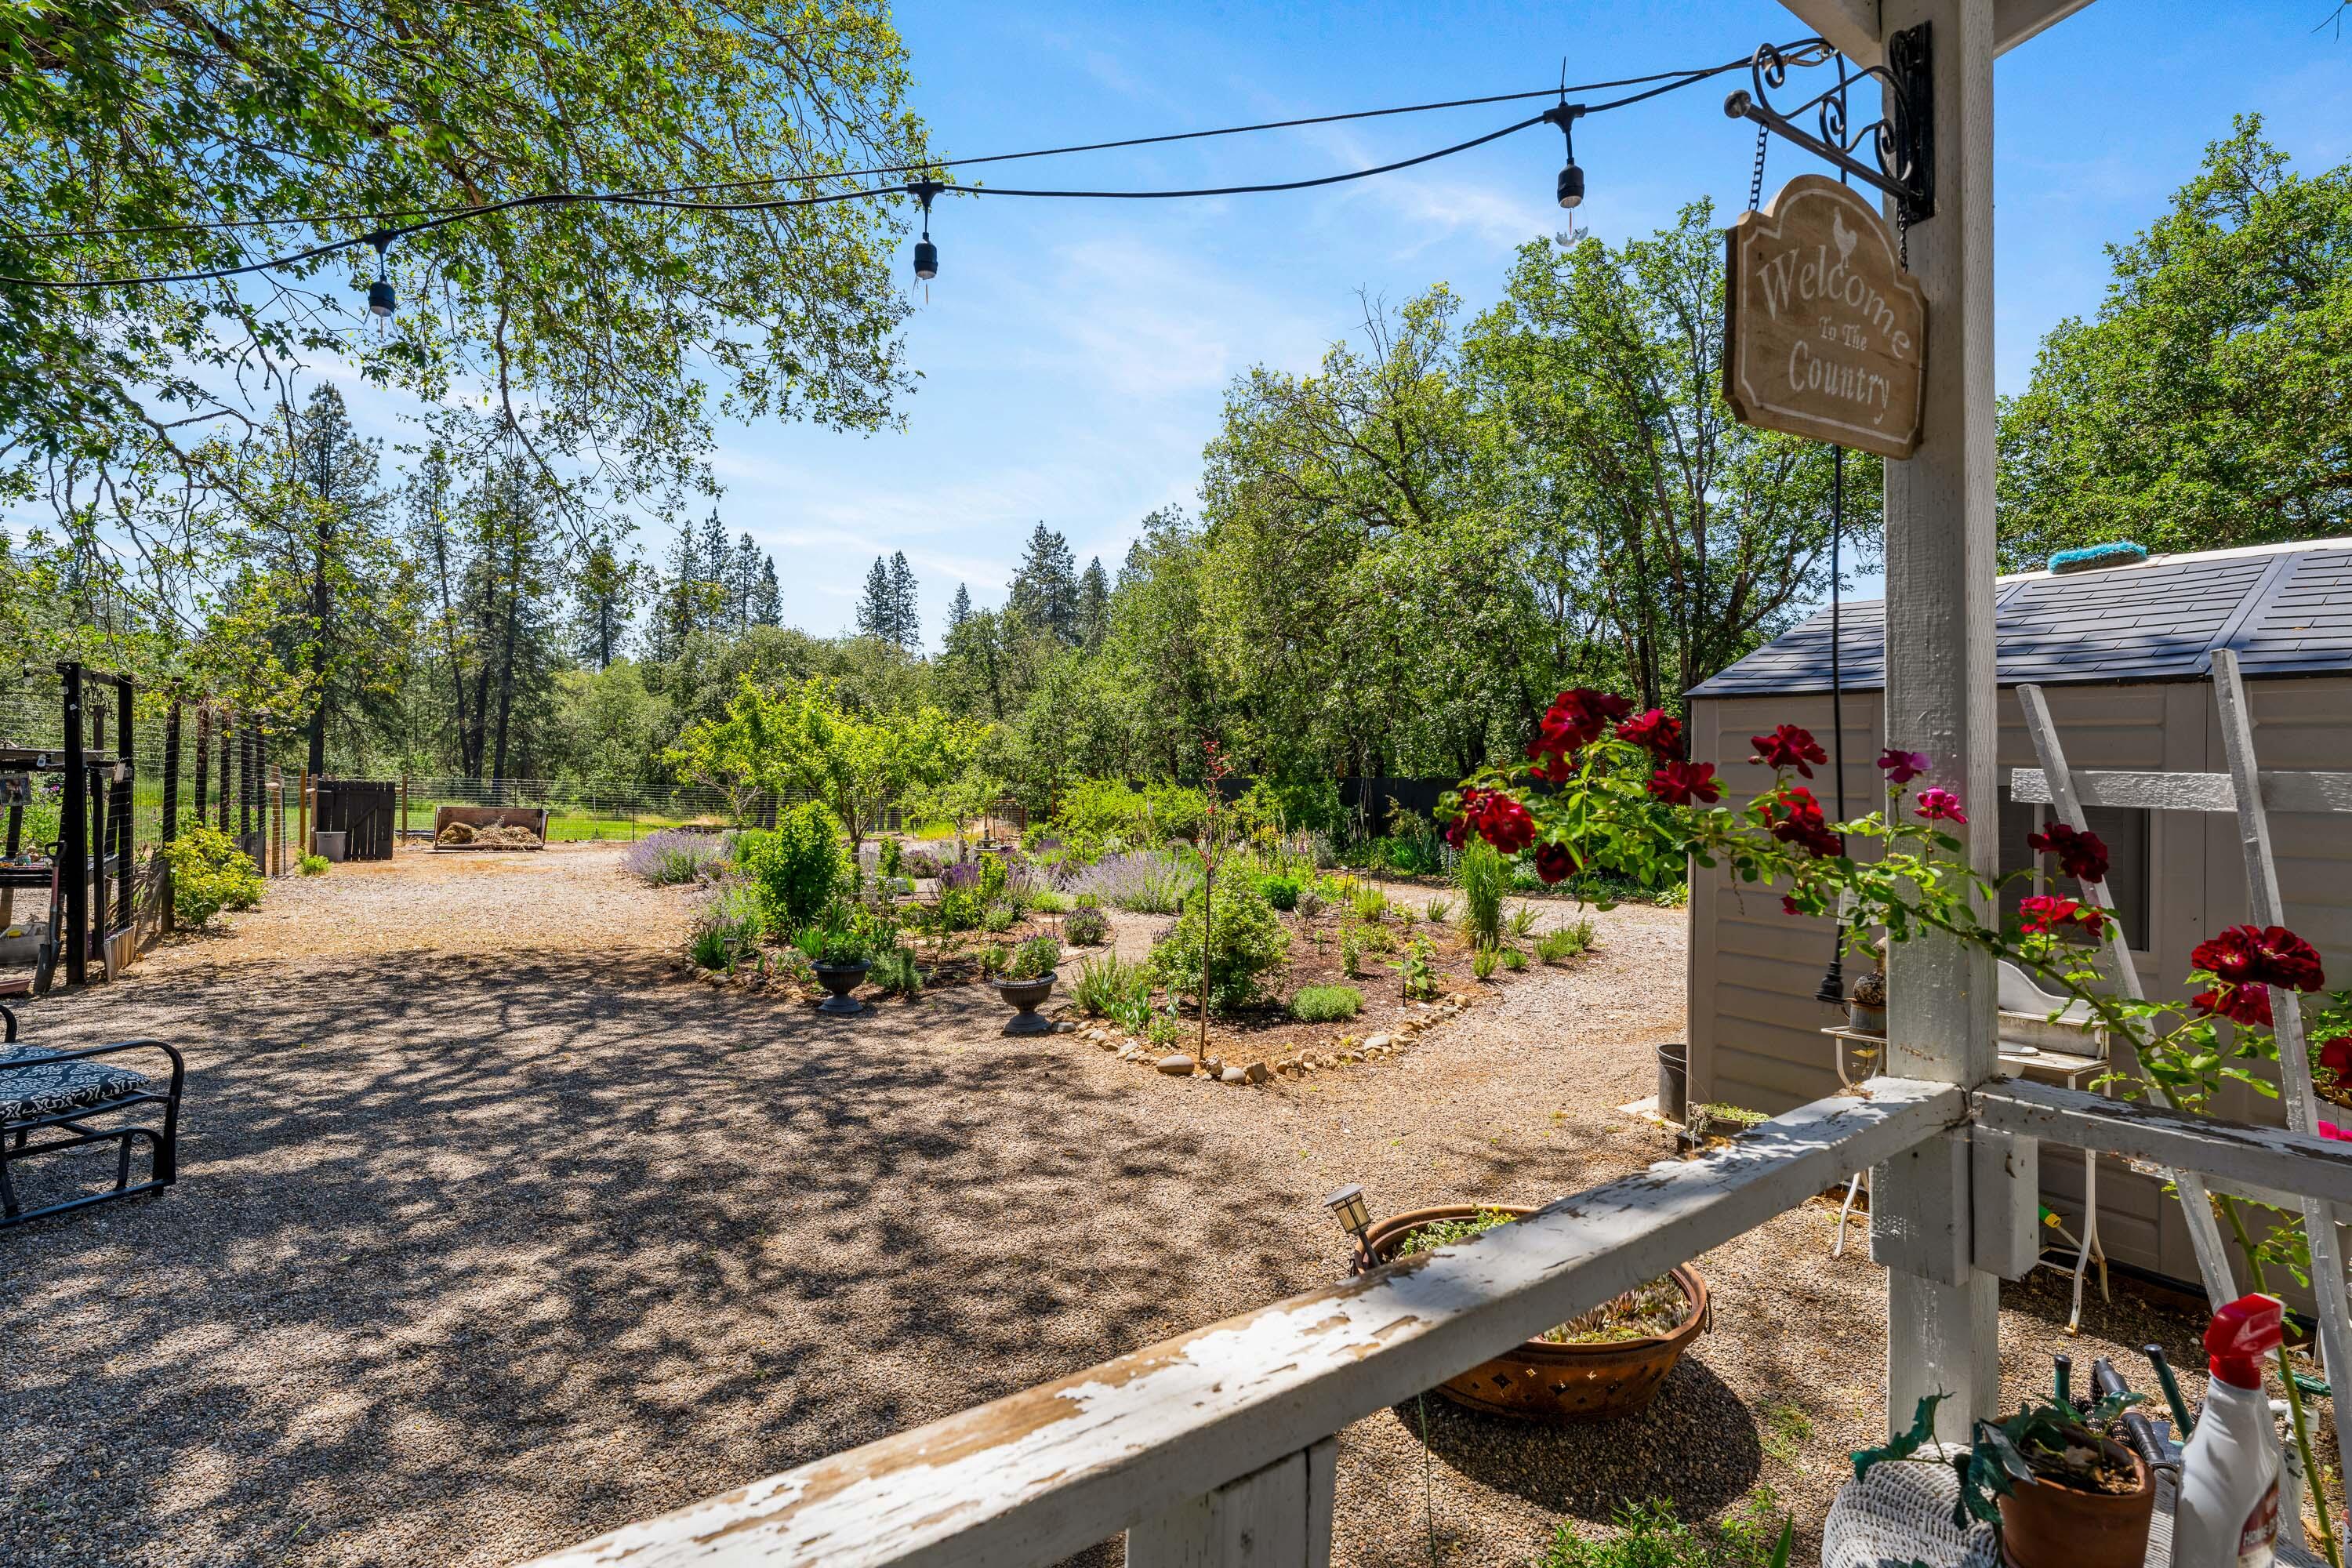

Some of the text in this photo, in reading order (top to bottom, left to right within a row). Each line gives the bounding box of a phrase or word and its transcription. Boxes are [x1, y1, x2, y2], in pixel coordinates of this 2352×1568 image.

[1756, 245, 1910, 358] Welcome
[1819, 316, 1867, 350] To The
[1789, 340, 1889, 425] Country
